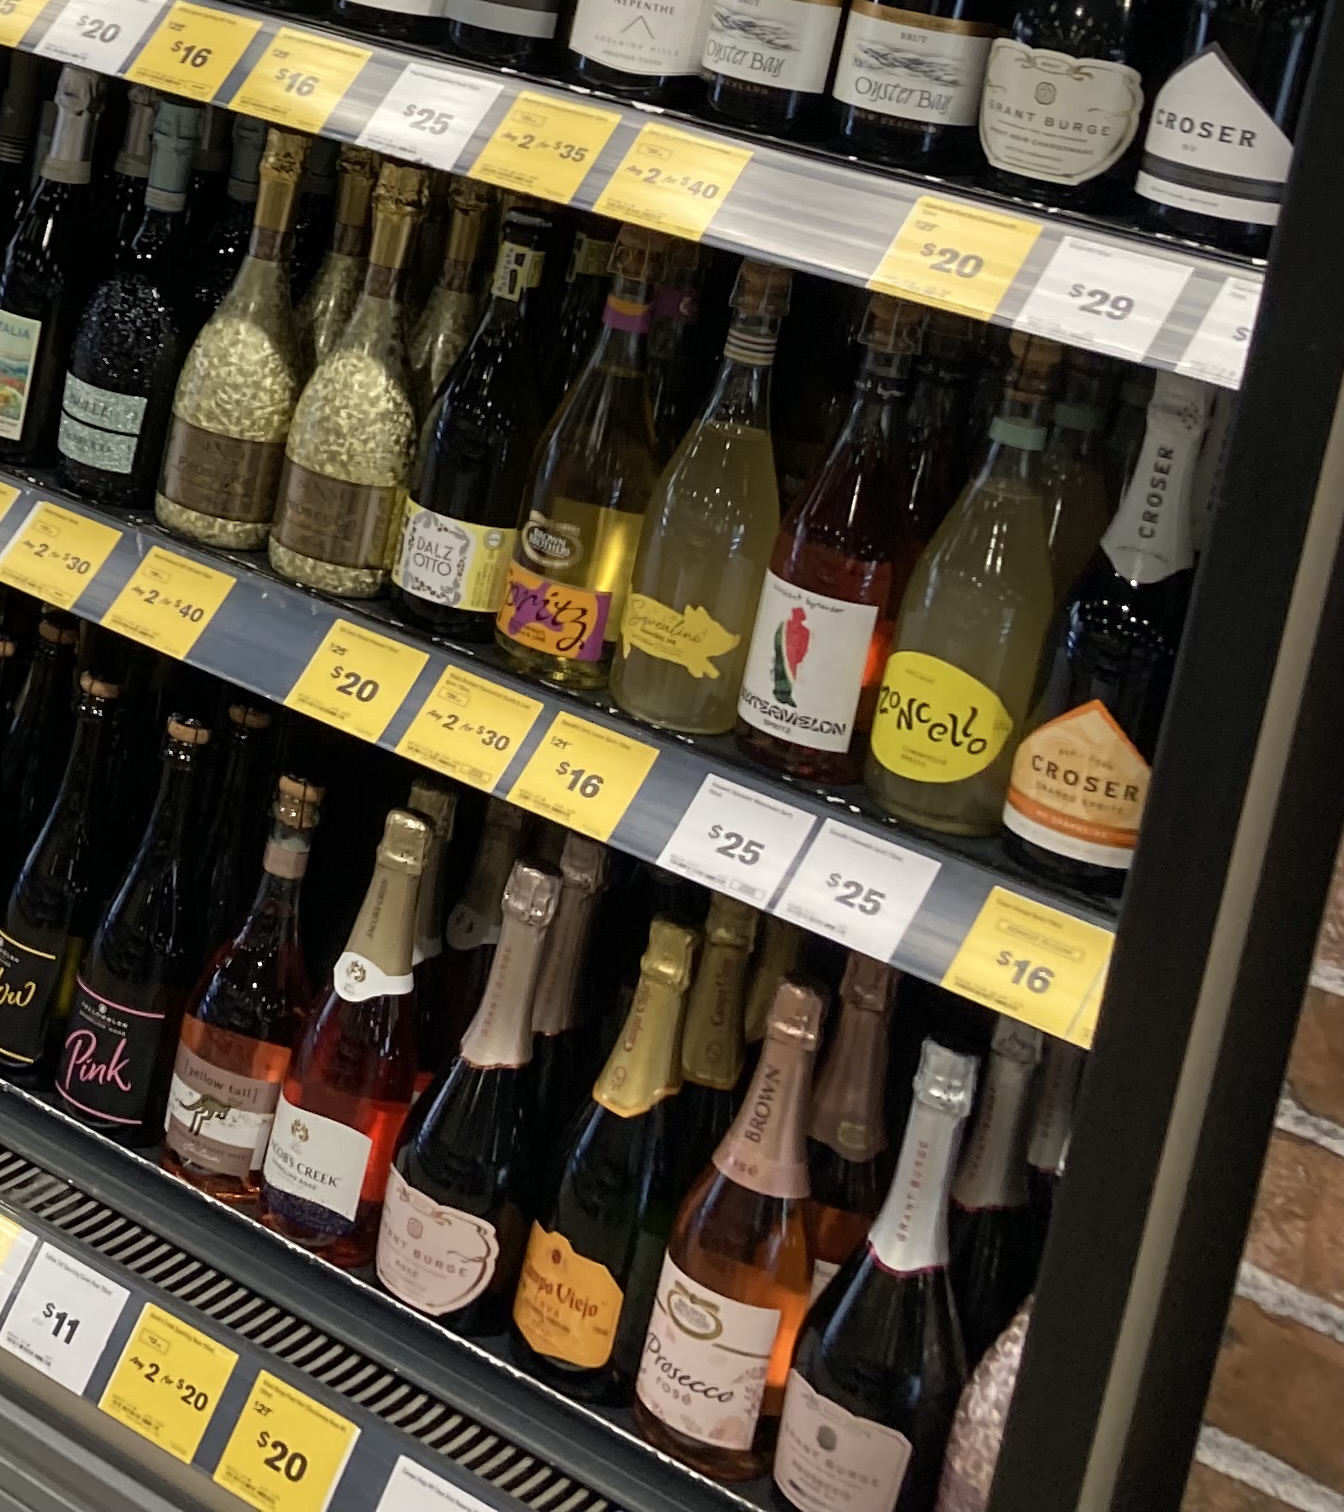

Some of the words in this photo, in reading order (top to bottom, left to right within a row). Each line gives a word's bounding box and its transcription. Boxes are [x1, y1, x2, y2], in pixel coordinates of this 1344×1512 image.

[76, 15, 120, 43] $20
[899, 32, 929, 44] BRUT
[171, 40, 212, 68] $16
[275, 68, 317, 98] $16
[403, 104, 454, 136] $25
[1044, 116, 1111, 138] BURGE
[1155, 107, 1258, 149] CROSER
[517, 134, 535, 150] 2
[552, 141, 589, 163] $35
[645, 167, 662, 185] 2
[680, 176, 720, 201] $40
[919, 242, 984, 279] $20
[1068, 282, 1135, 321] $29
[1139, 443, 1175, 539] CROSER
[413, 553, 452, 577] OTTO
[417, 536, 455, 561] DALZ
[330, 665, 379, 702] $20
[443, 713, 458, 731] 2
[475, 725, 510, 752] $30
[556, 760, 605, 799] $16
[1031, 754, 1139, 803] CROSER
[709, 825, 765, 866] $25
[826, 873, 885, 917] $25
[997, 951, 1055, 995] $16
[65, 1029, 132, 1091] Pink
[745, 1064, 782, 1143] BROWN
[296, 1162, 339, 1189] CREEK
[413, 1247, 468, 1278] BURGE
[556, 1283, 599, 1318] Viejo
[43, 1301, 79, 1346] $11
[647, 1332, 734, 1404] Prosecco
[144, 1363, 160, 1383] 2
[175, 1377, 209, 1412] $20
[256, 1431, 308, 1483] $20
